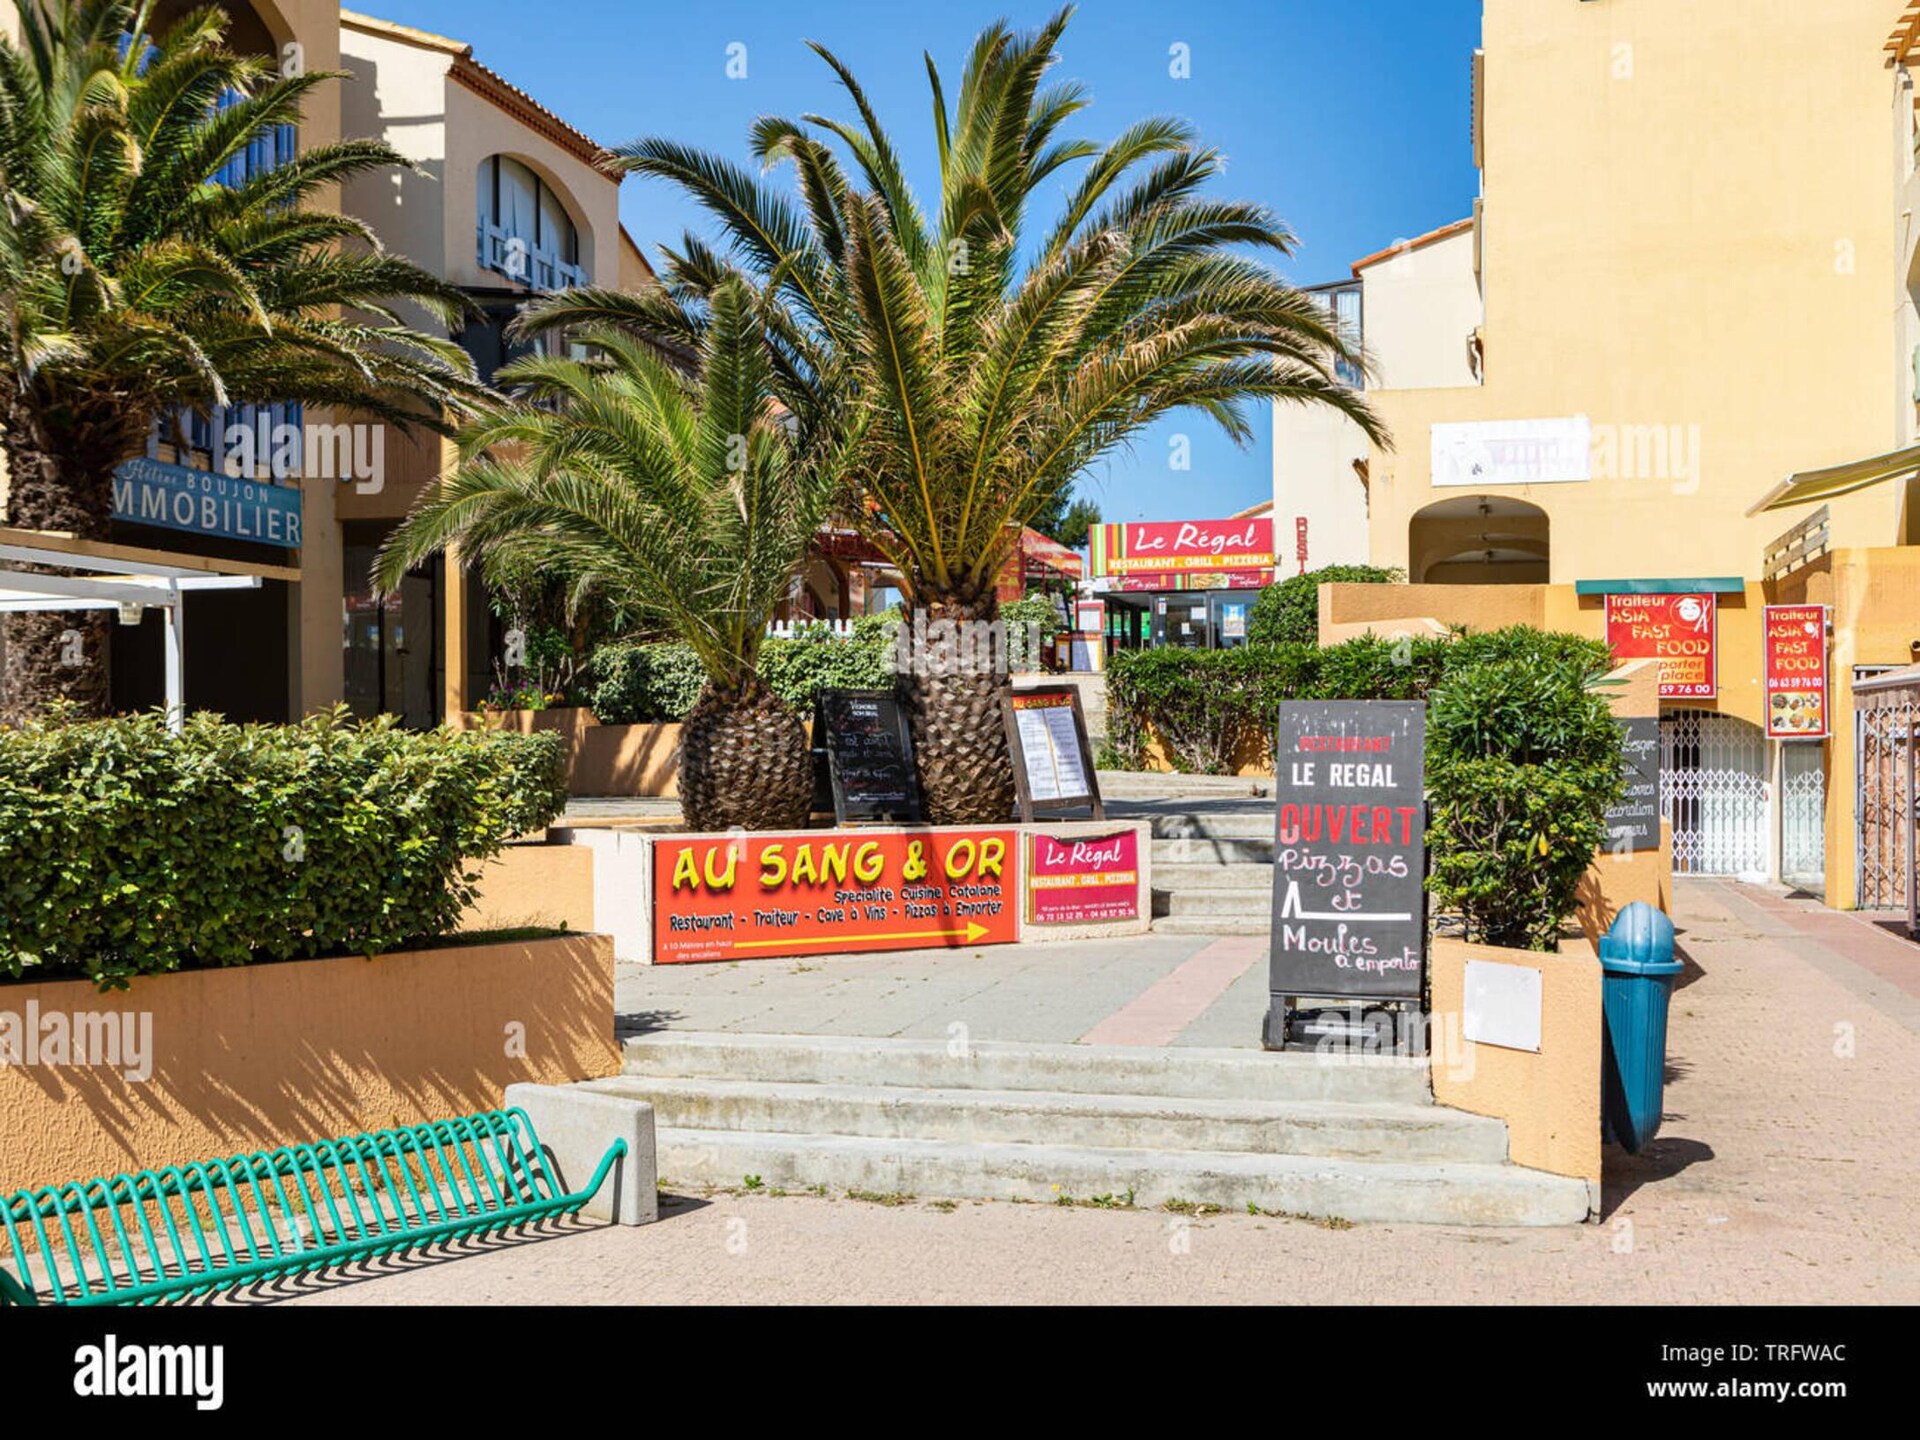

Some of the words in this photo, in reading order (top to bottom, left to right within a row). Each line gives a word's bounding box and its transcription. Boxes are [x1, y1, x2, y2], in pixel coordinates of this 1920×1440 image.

[187, 472, 268, 503] BOUJON
[112, 477, 300, 543] MMOBILIER
[1135, 527, 1167, 551] Le
[1174, 523, 1259, 555] Régal
[1109, 559, 1176, 570] RESTAURANT
[1185, 557, 1213, 568] GRILL
[1223, 555, 1270, 566] PIZZERIA
[1610, 595, 1666, 607] Traiteur
[1610, 608, 1650, 623] ASIA
[1769, 611, 1818, 621] Traiteur
[1632, 624, 1672, 639] FAST
[1769, 624, 1801, 638] ASIA
[1657, 639, 1710, 655] FOOD
[1775, 641, 1808, 654] FAST
[1775, 657, 1820, 670] FOOD
[1661, 671, 1703, 681] place
[1812, 677, 1822, 687] 00
[1660, 685, 1674, 694] 59
[1678, 685, 1691, 694] 76
[1695, 685, 1710, 694] 00
[1300, 736, 1392, 753] RESTAURANT
[1292, 763, 1315, 786] LE
[1330, 763, 1398, 787] REGAL
[1280, 803, 1417, 846] OUVERT
[672, 845, 739, 889] AU
[760, 841, 885, 886] SANG
[903, 840, 927, 881] &
[945, 837, 1006, 879] OR
[1045, 843, 1066, 866] Le
[1070, 840, 1122, 870] Régal
[1278, 848, 1409, 887] Pizzas
[901, 886, 942, 900] Cuisine
[950, 884, 1001, 898] Catalane
[1331, 890, 1362, 911] et
[670, 911, 735, 932] Restaurant
[753, 908, 801, 927] Traiteur
[817, 908, 844, 923] Cave
[865, 905, 886, 921] Vins
[905, 902, 937, 920] Pizzas
[956, 901, 1003, 918] Emporter
[1282, 923, 1378, 955] Moules
